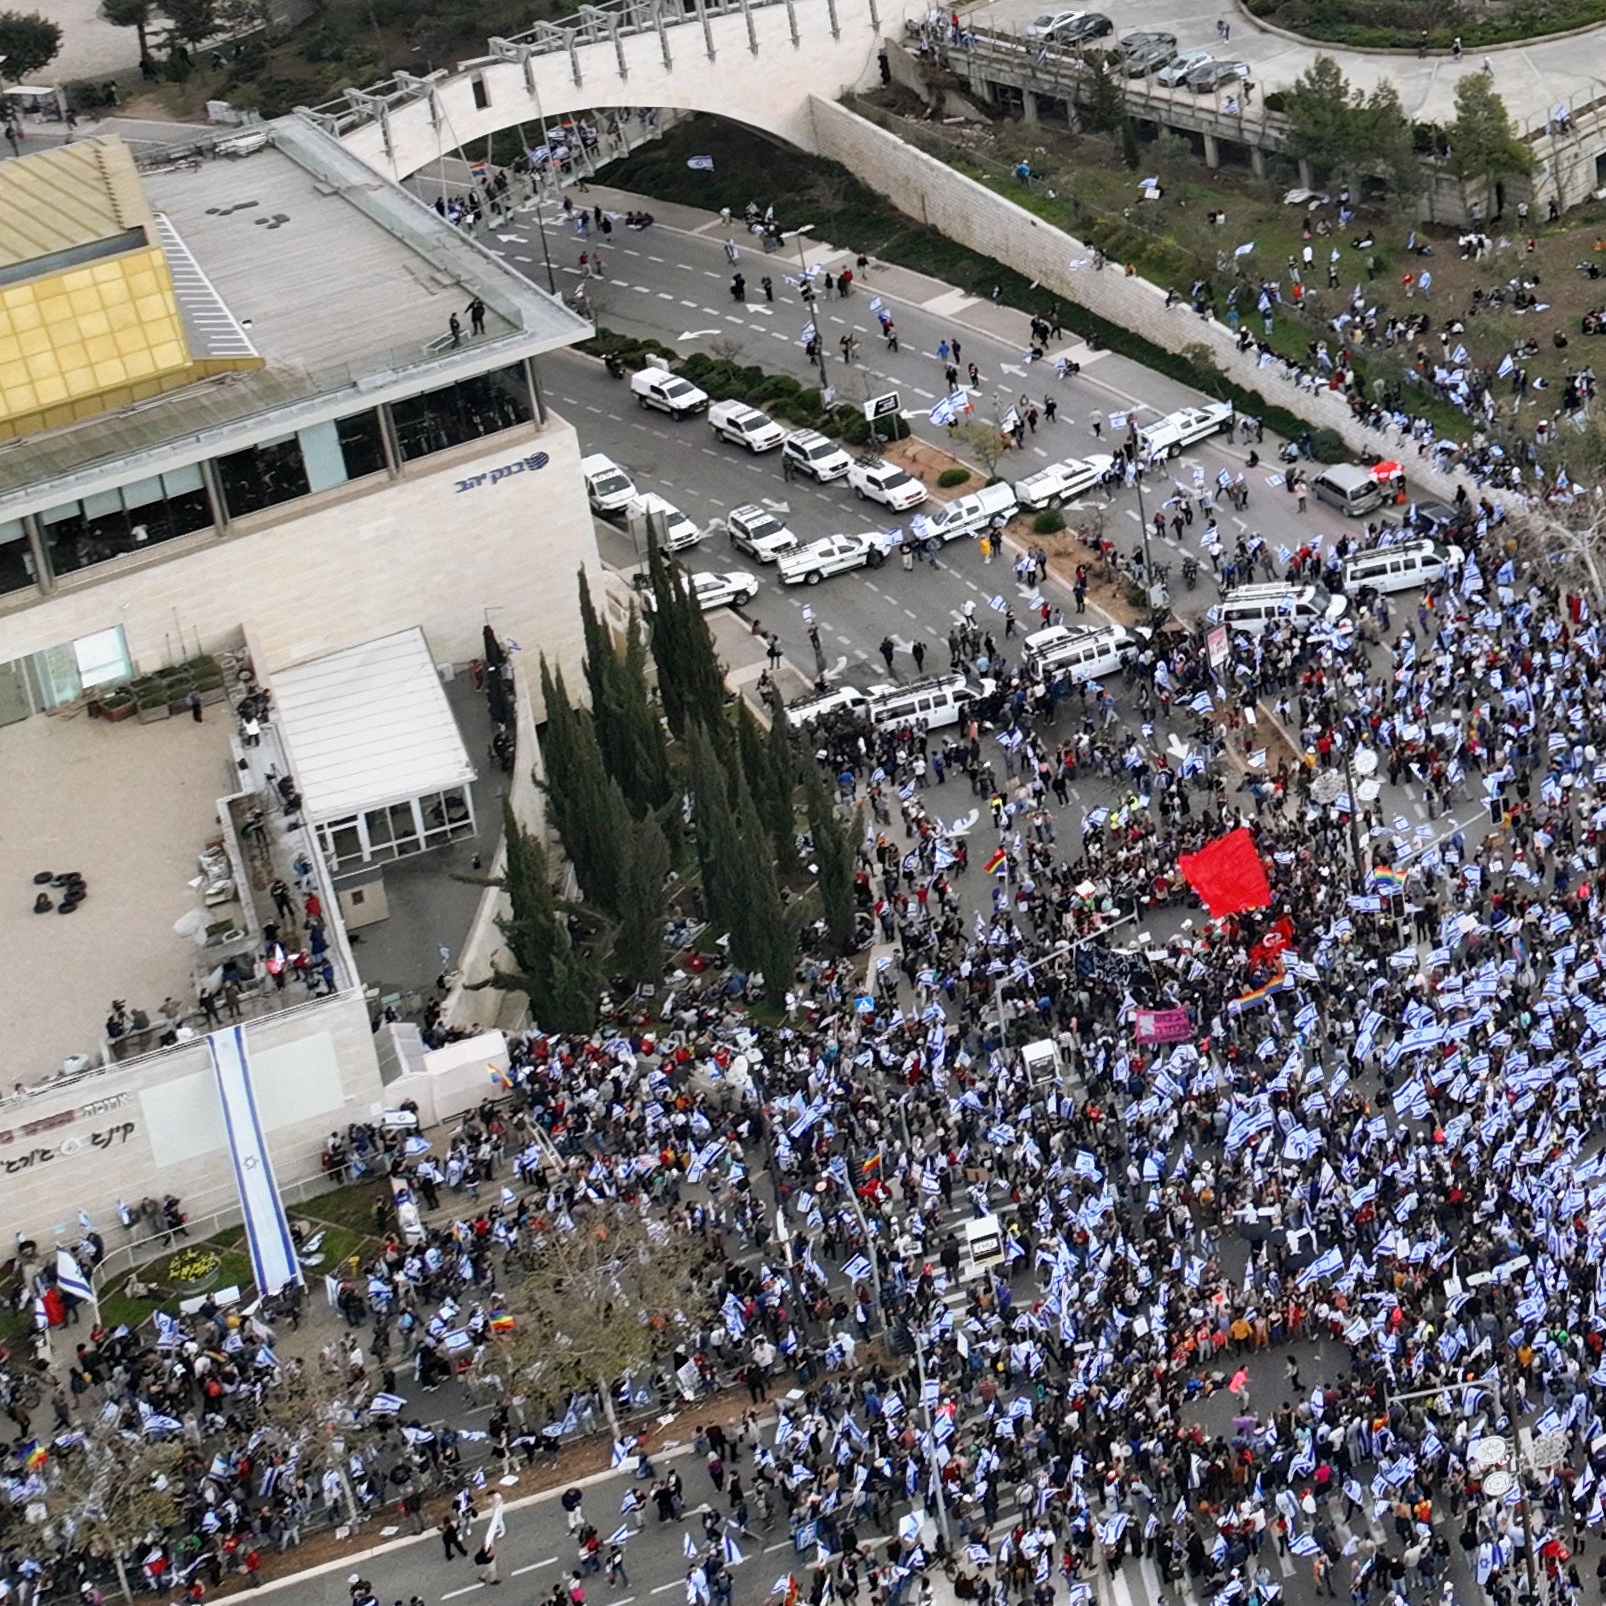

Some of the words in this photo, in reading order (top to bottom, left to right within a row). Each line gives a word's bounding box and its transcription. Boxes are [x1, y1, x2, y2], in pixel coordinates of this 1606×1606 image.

[454, 473, 487, 494] יהב
[488, 461, 526, 485] בנק
[91, 1122, 135, 1149] קינג
